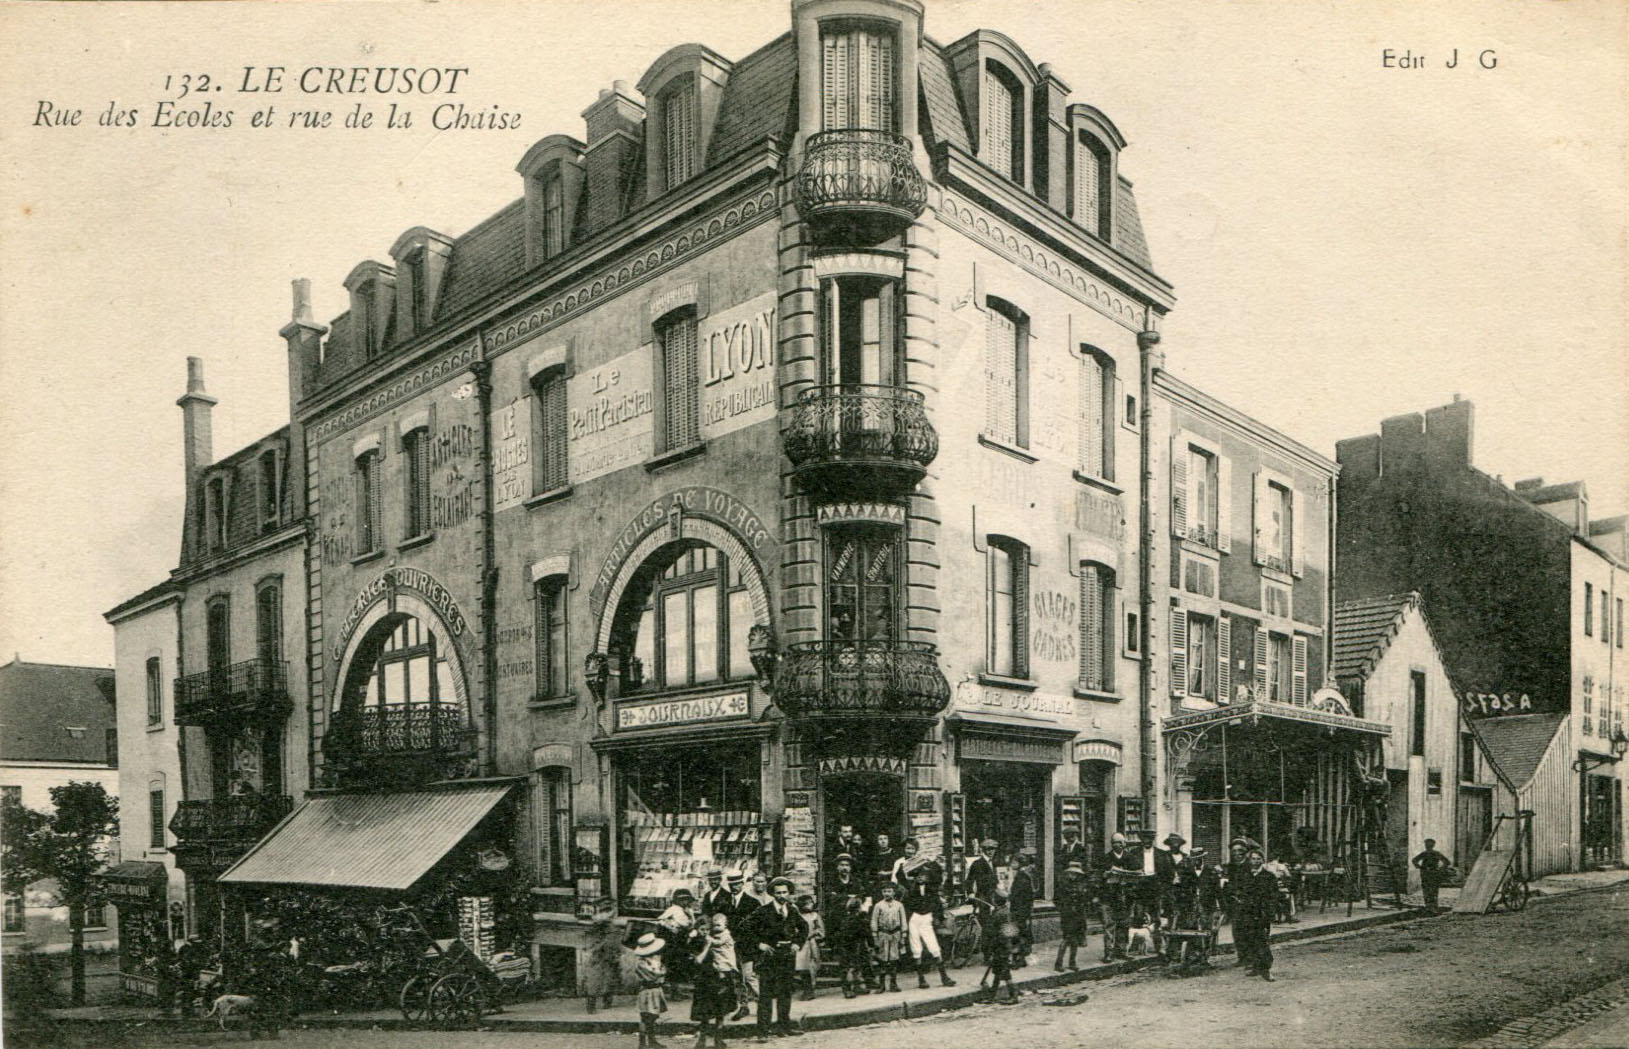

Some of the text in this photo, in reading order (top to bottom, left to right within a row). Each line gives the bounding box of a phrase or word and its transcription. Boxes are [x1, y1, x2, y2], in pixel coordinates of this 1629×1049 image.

[703, 307, 775, 388] LYON
[592, 368, 620, 395] Le
[502, 406, 517, 441] LE
[598, 501, 664, 587] ARTICLES
[705, 489, 768, 550] VOYAGE
[831, 542, 890, 581] VANNERIE SPARTERIE
[395, 568, 464, 636] OUVRIERES
[1034, 591, 1076, 626] GLACES
[1033, 627, 1076, 662] CADRES
[638, 697, 727, 724] JOURNAUX
[981, 690, 1073, 715] LE JOURNAL
